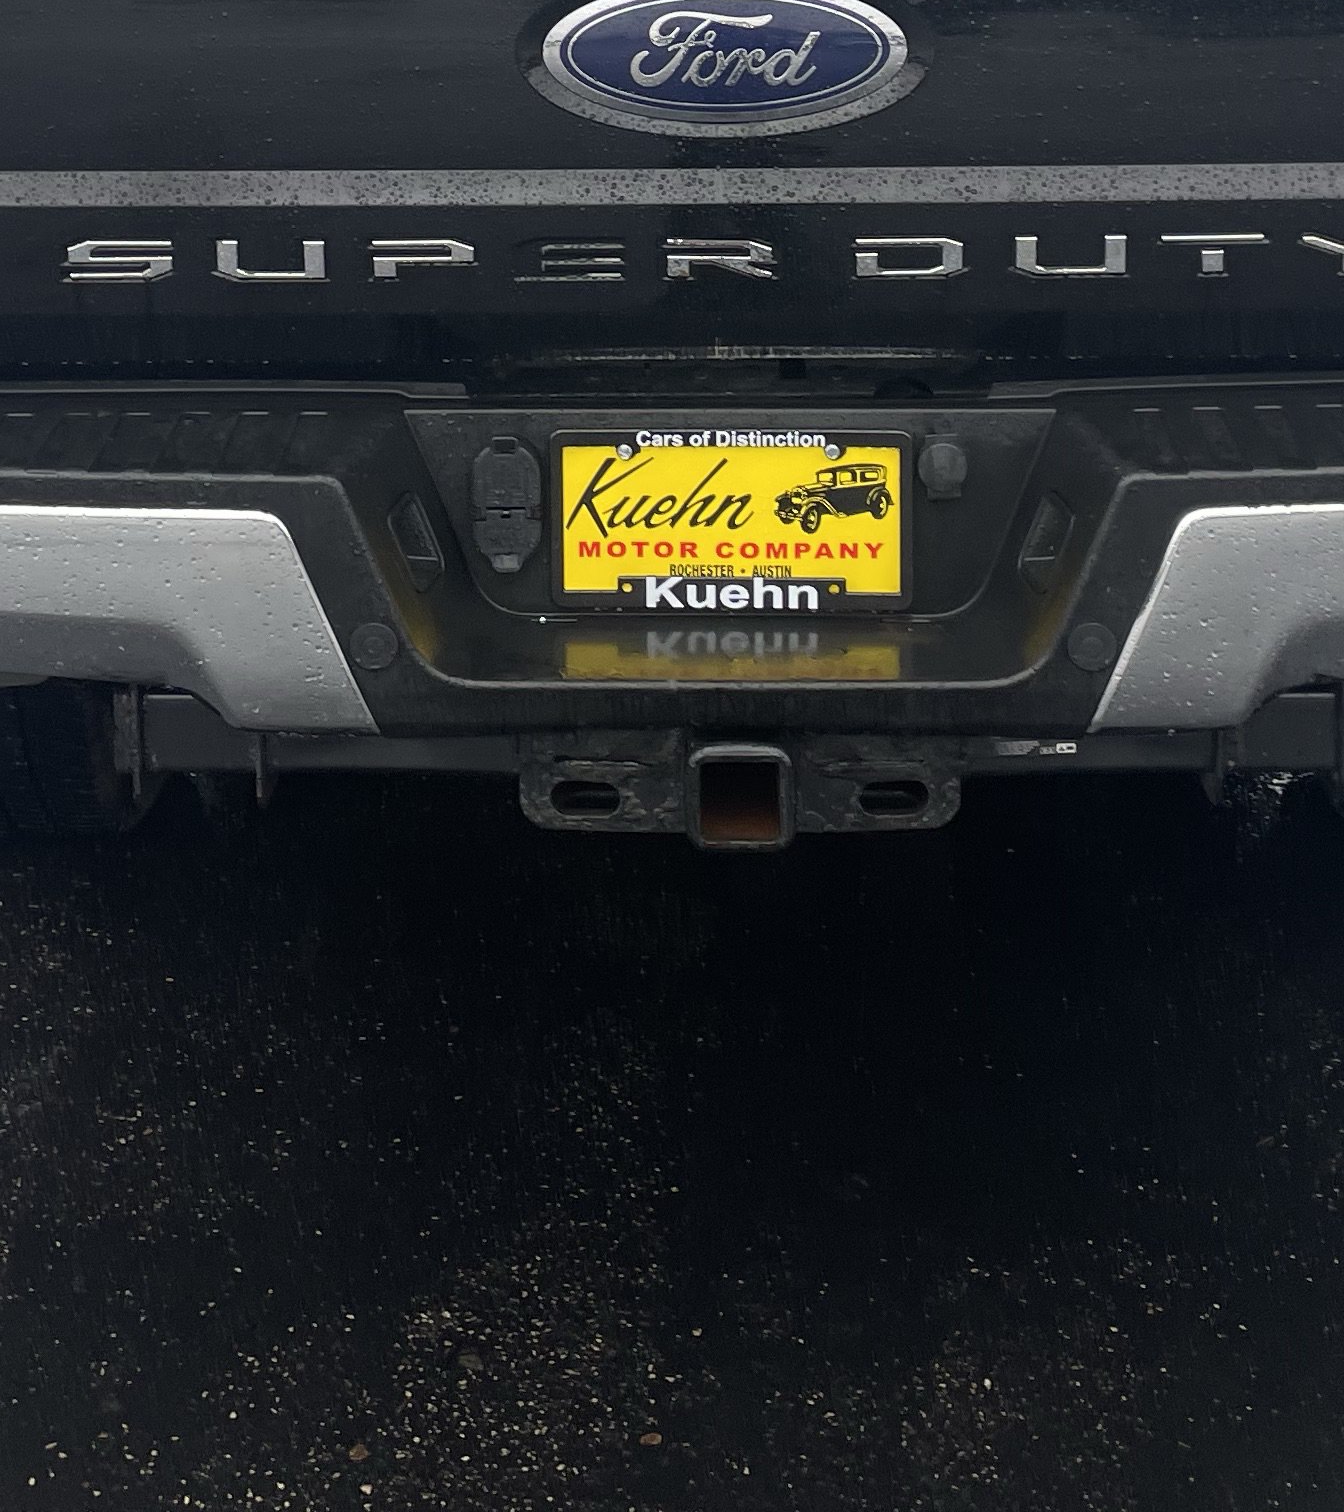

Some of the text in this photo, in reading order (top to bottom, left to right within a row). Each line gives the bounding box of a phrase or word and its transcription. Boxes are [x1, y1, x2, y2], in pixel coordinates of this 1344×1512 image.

[630, 11, 821, 87] Ford
[64, 238, 776, 282] SUPER
[636, 430, 826, 448] Cars of Distinction
[566, 456, 754, 538] Kuehn
[578, 541, 885, 559] MOTOR COMPANY
[669, 563, 792, 578] ROCHESTER AUSTIN
[644, 576, 819, 609] Kuehn
